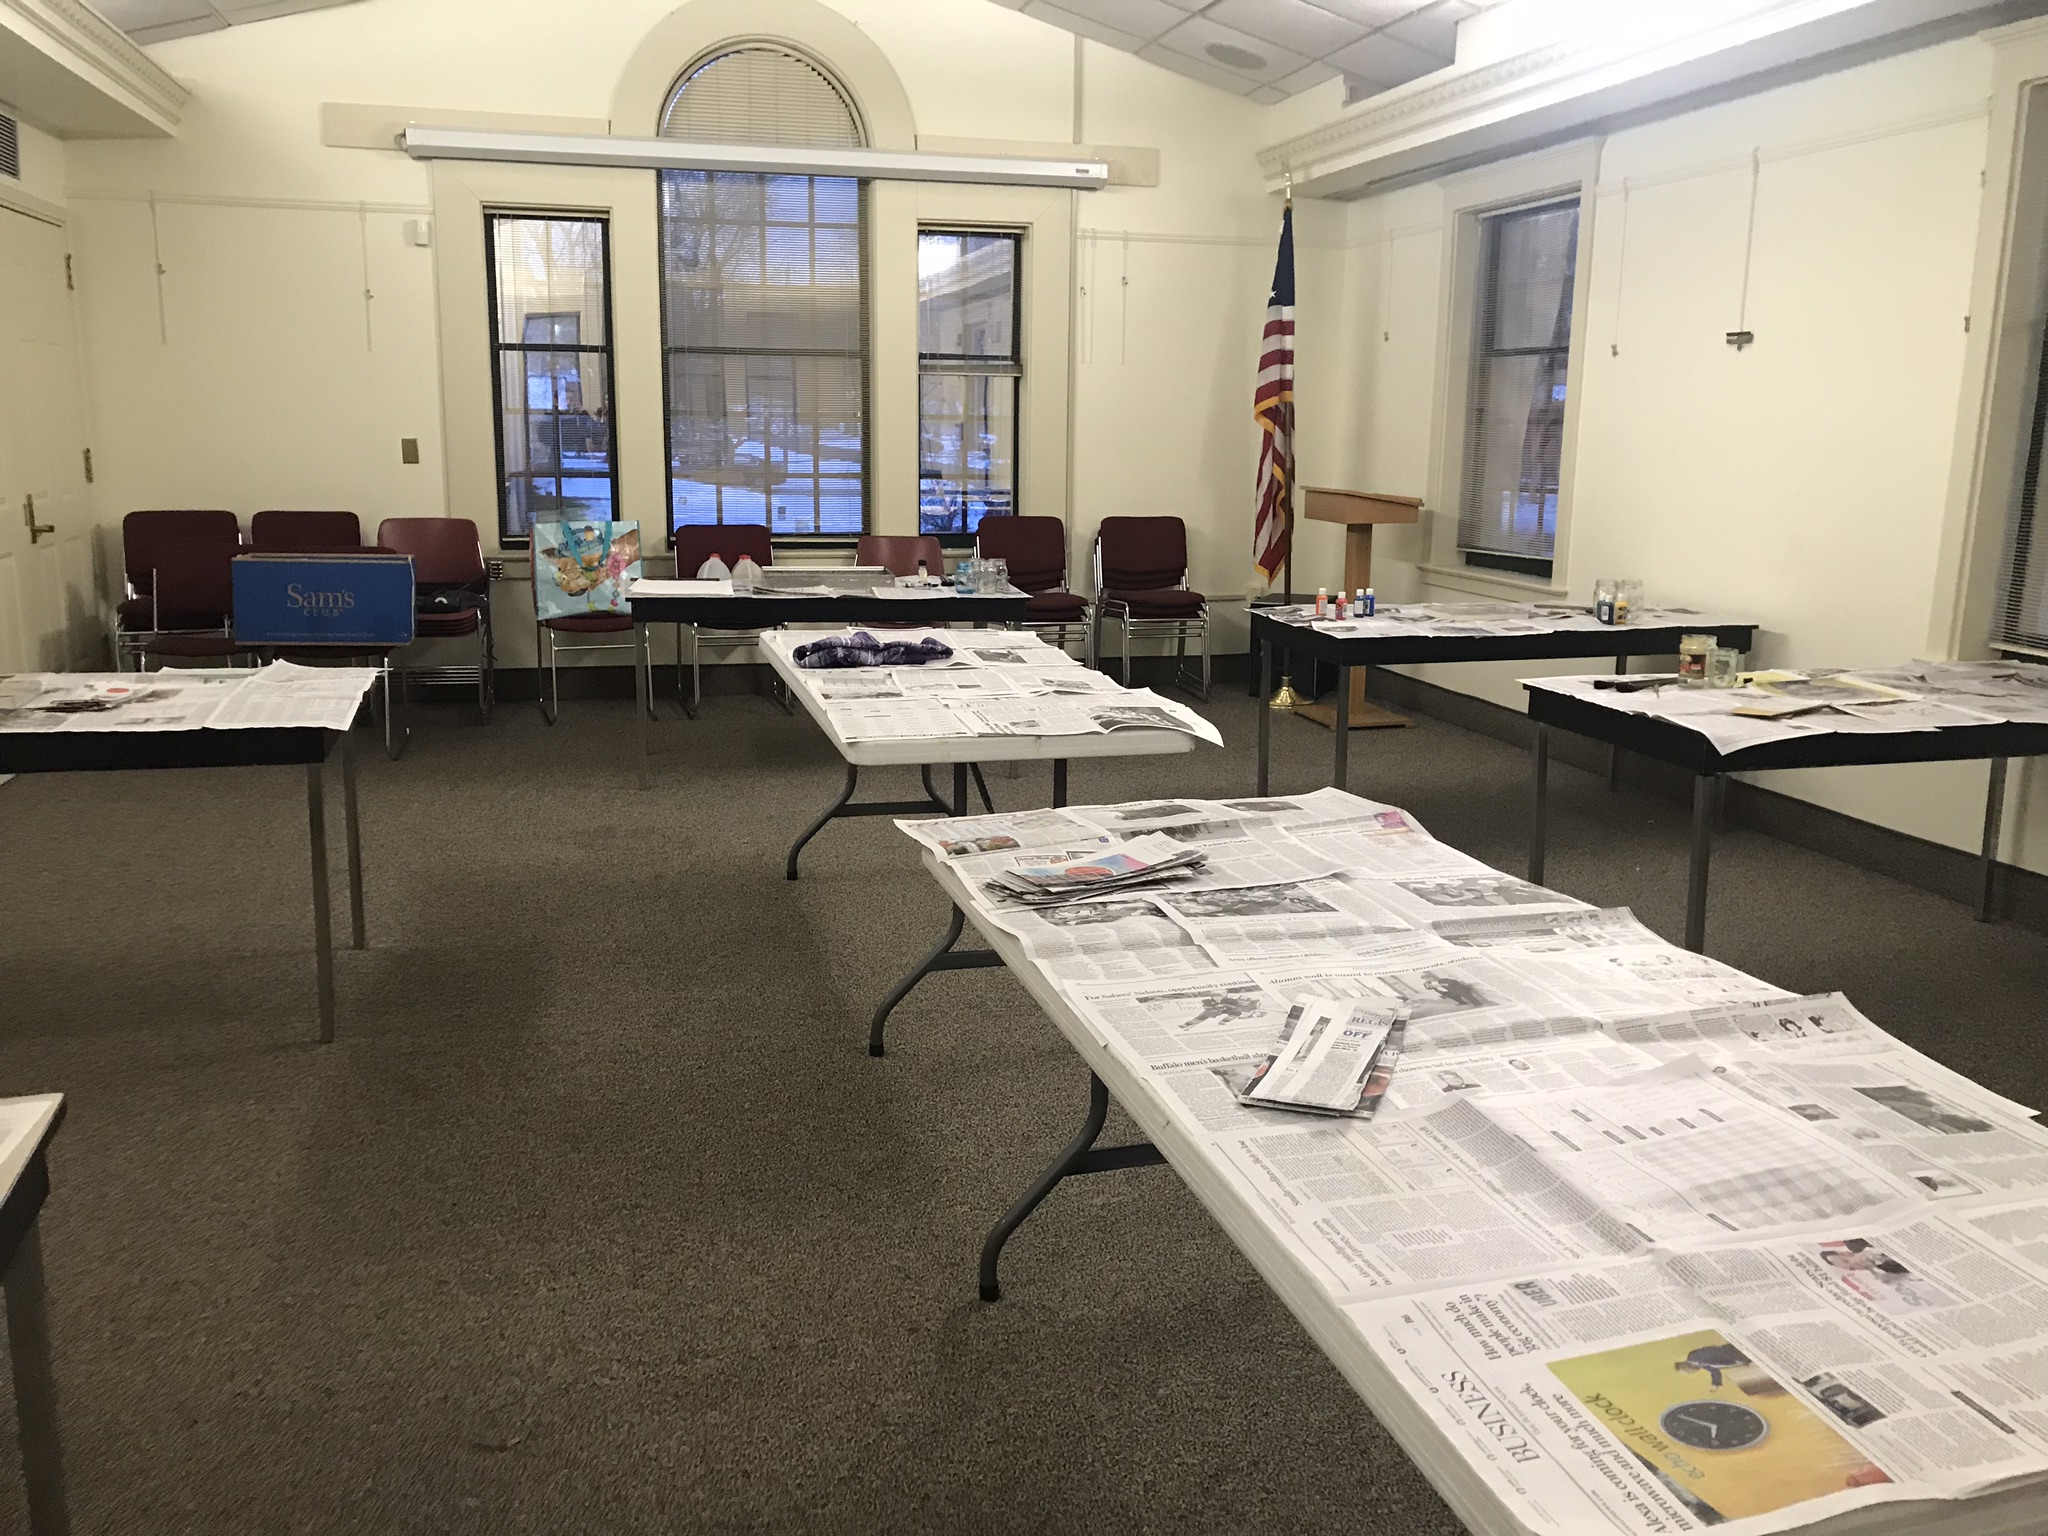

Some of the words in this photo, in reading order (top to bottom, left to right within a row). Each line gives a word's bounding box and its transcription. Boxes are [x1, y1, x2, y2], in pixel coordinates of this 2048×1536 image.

[287, 583, 355, 608] Sam's
[304, 608, 339, 617] CLUB
[1468, 918, 1545, 931] marketplace
[1267, 976, 1301, 984] Alumni
[1342, 1030, 1372, 1038] OFF
[1150, 1061, 1183, 1070] Buffalo
[1183, 1058, 1207, 1066] men's
[1207, 1053, 1250, 1063] basketball
[1453, 1294, 1473, 1304] in
[1512, 1280, 1559, 1307] UBER
[1439, 1301, 1462, 1314] do
[1461, 1303, 1495, 1328] make
[1450, 1313, 1484, 1338] much
[1473, 1338, 1504, 1360] How
[1483, 1327, 1525, 1357] people
[1439, 1368, 1541, 1463] BUSINESS
[1547, 1393, 1584, 1419] more
[1580, 1391, 1637, 1427] clock
[1543, 1409, 1578, 1433] your
[1561, 1434, 1589, 1450] for
[1570, 1419, 1613, 1449] much
[1623, 1426, 1670, 1453] wall
[1577, 1448, 1634, 1491] coming
[1600, 1449, 1635, 1471] and
[1657, 1451, 1708, 1481] echo
[1616, 1490, 1640, 1502] is
[1621, 1471, 1695, 1531] microwave
[1626, 1502, 1673, 1533] Alexa
